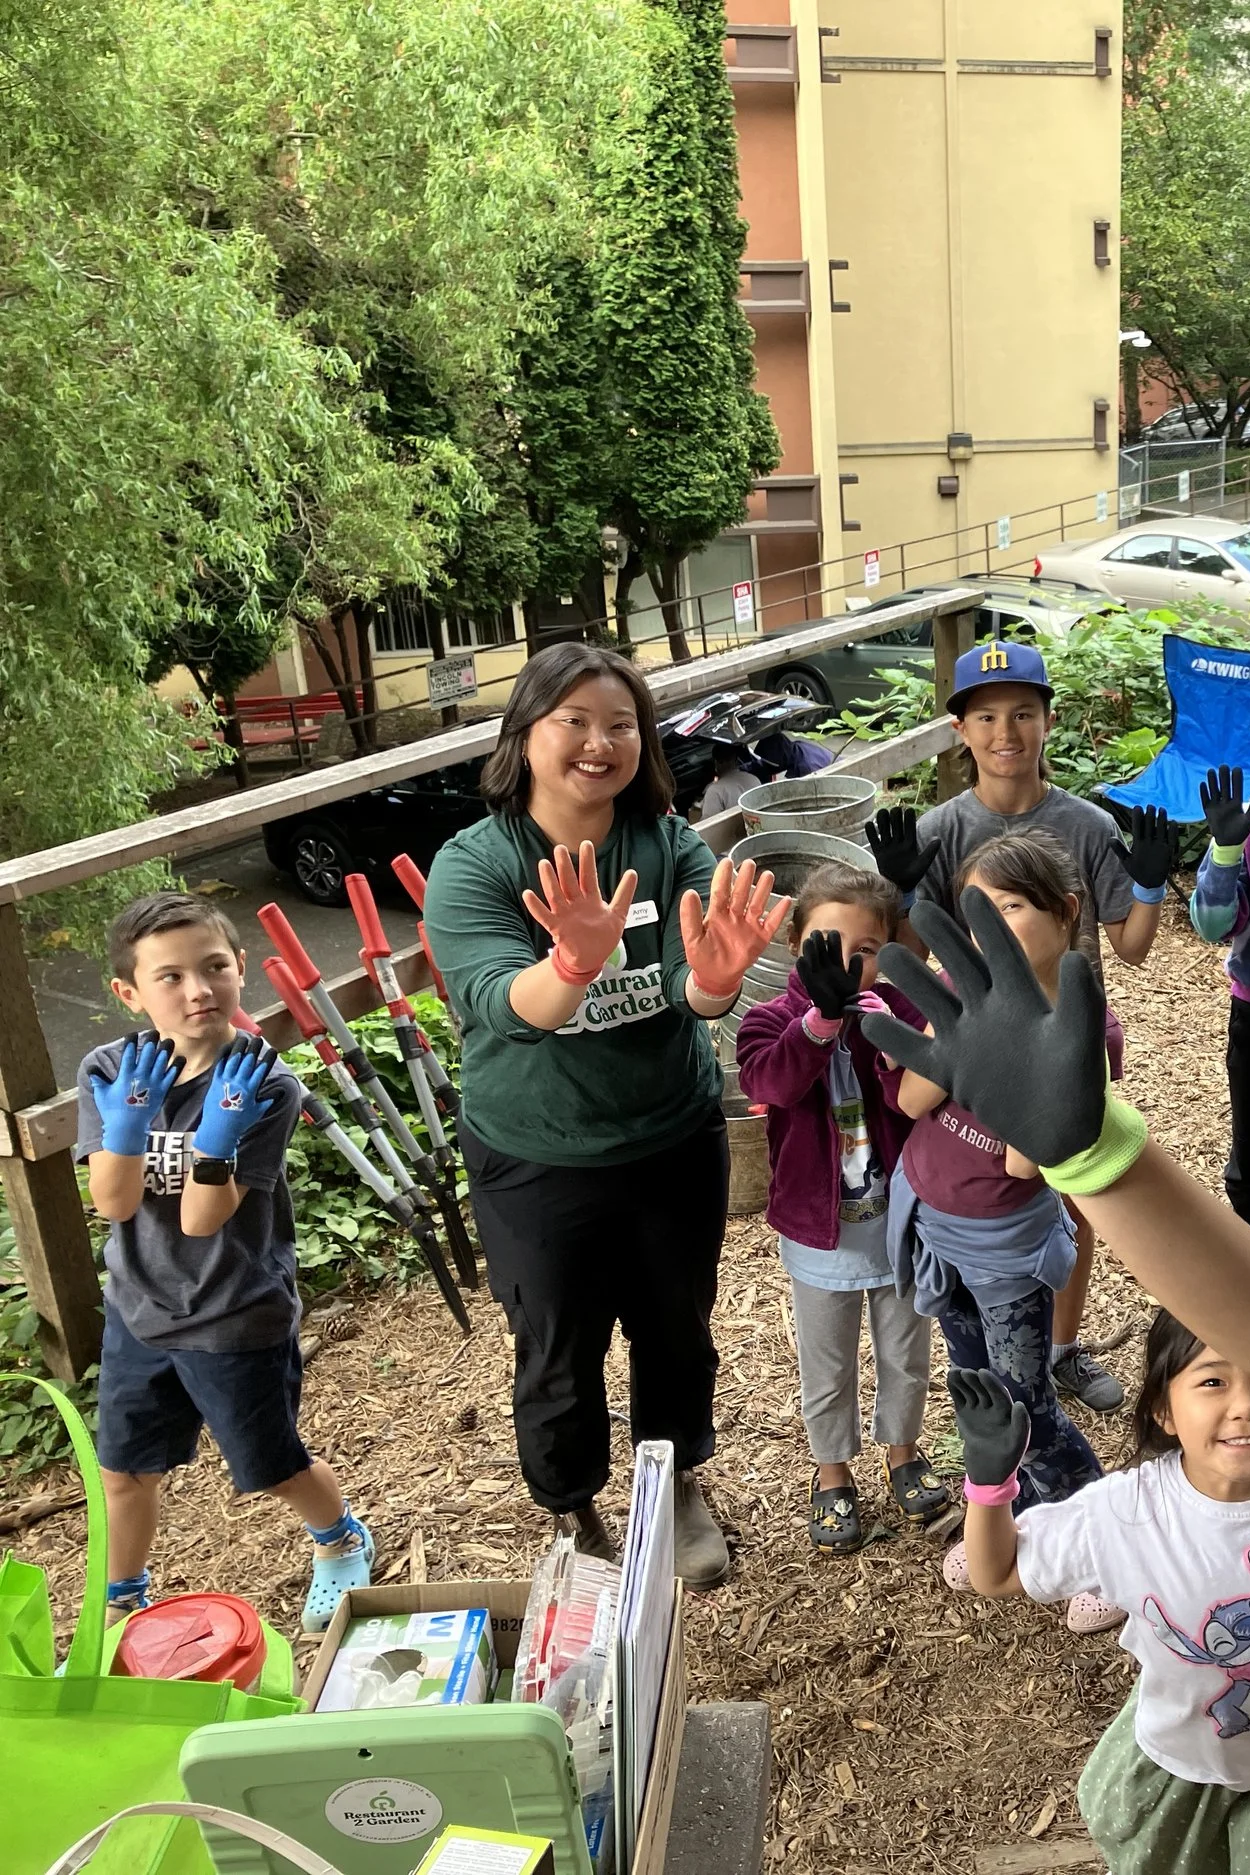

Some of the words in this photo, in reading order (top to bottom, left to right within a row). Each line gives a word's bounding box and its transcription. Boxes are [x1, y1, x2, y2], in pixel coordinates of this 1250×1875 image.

[940, 1111, 959, 1133] ES
[958, 1124, 1006, 1156] AROUN
[360, 1618, 381, 1643] 100
[427, 1615, 456, 1637] M
[344, 1808, 427, 1820] Restaurant
[367, 1816, 421, 1826] Garden
[587, 1829, 600, 1850] Latex
